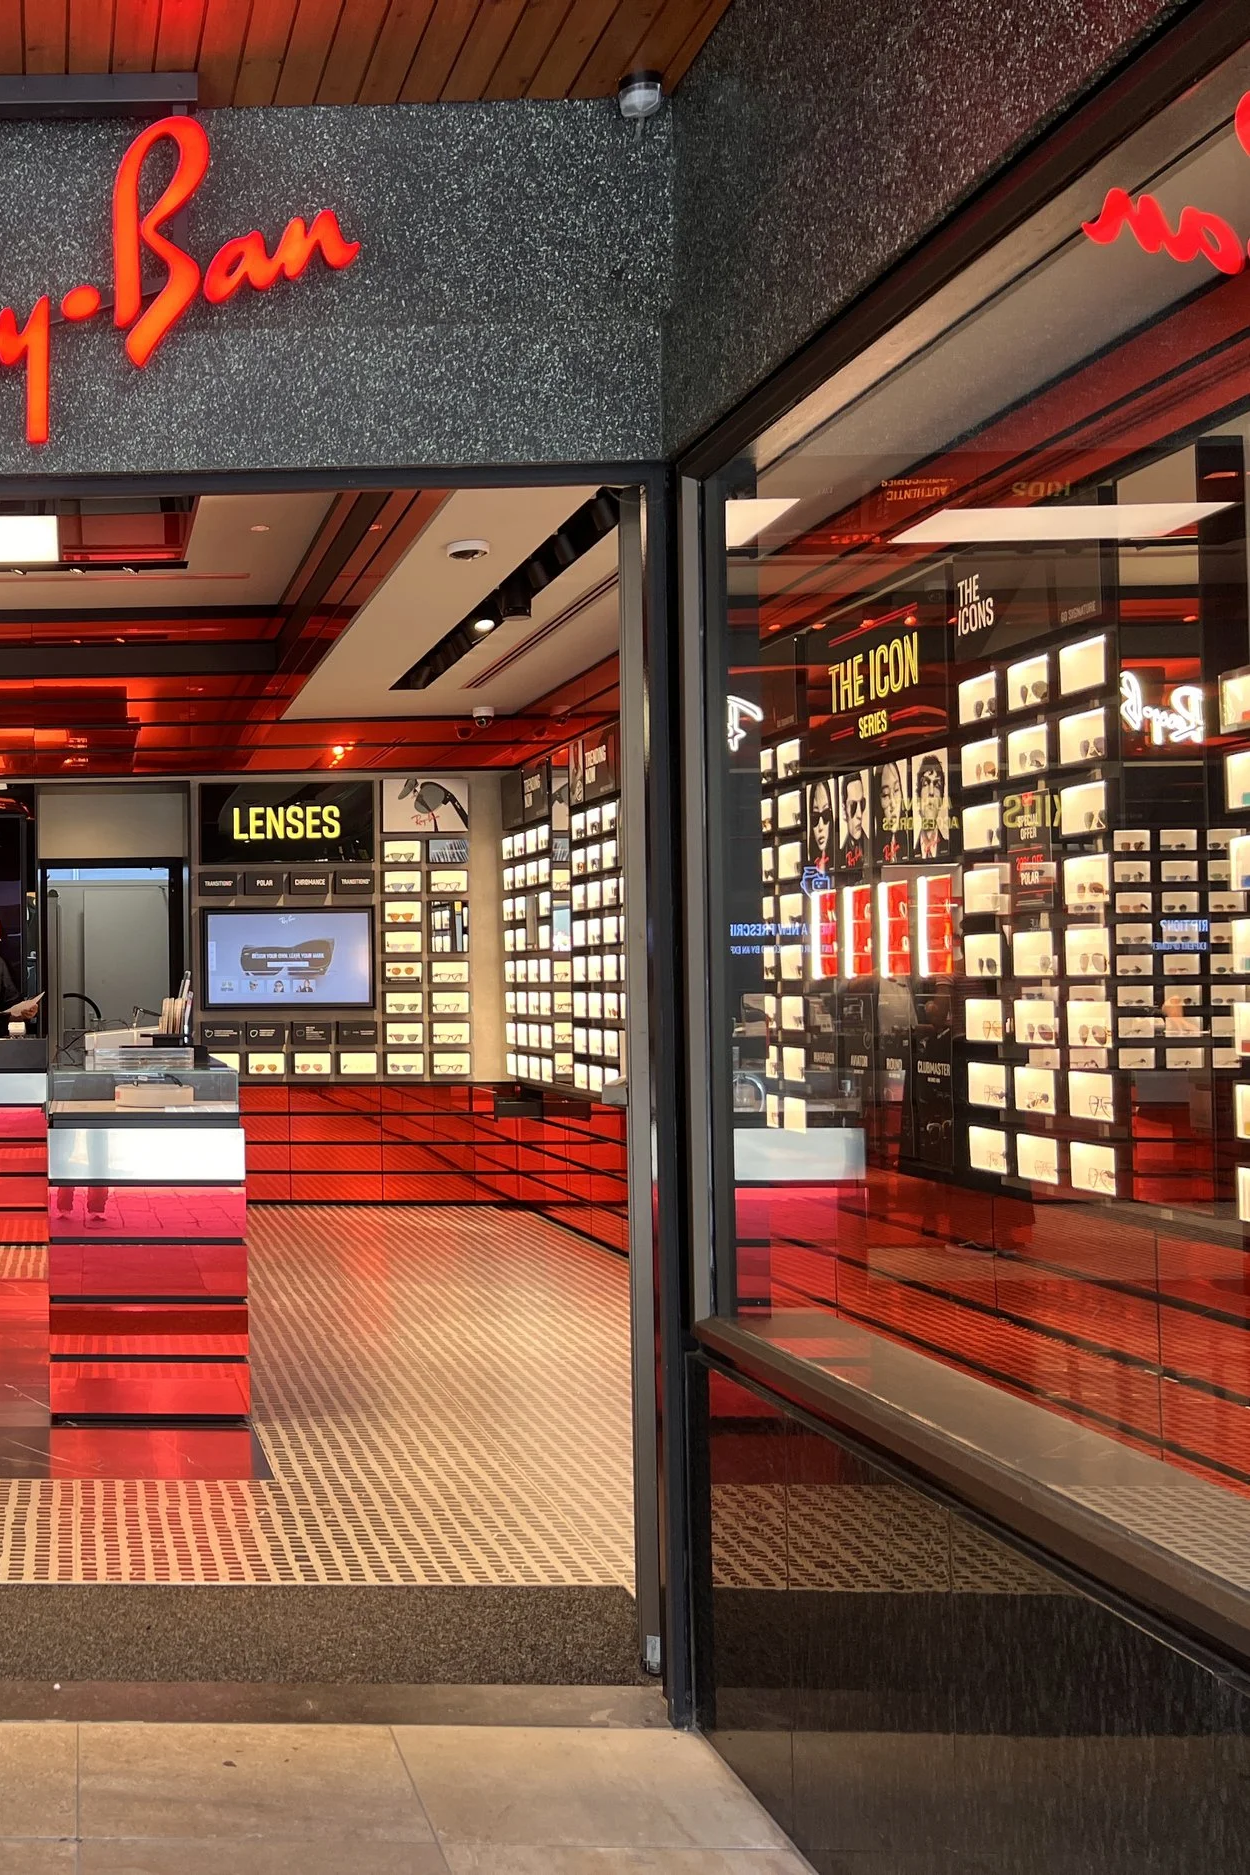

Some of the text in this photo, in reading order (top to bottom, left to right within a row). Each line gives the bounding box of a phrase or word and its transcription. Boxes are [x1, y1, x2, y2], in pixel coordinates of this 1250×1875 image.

[957, 573, 980, 607] THE
[957, 597, 993, 636] ICONS
[828, 631, 919, 713] THE ICON
[858, 709, 887, 739] SERIES
[233, 805, 341, 840] LENSES
[1019, 827, 1037, 841] OFFER
[256, 879, 273, 887] POLAR
[294, 878, 326, 886] CHROMANCE
[1020, 871, 1040, 885] POLAR
[886, 1057, 903, 1071] ROUND
[917, 1060, 951, 1077] CLUBMASTER
